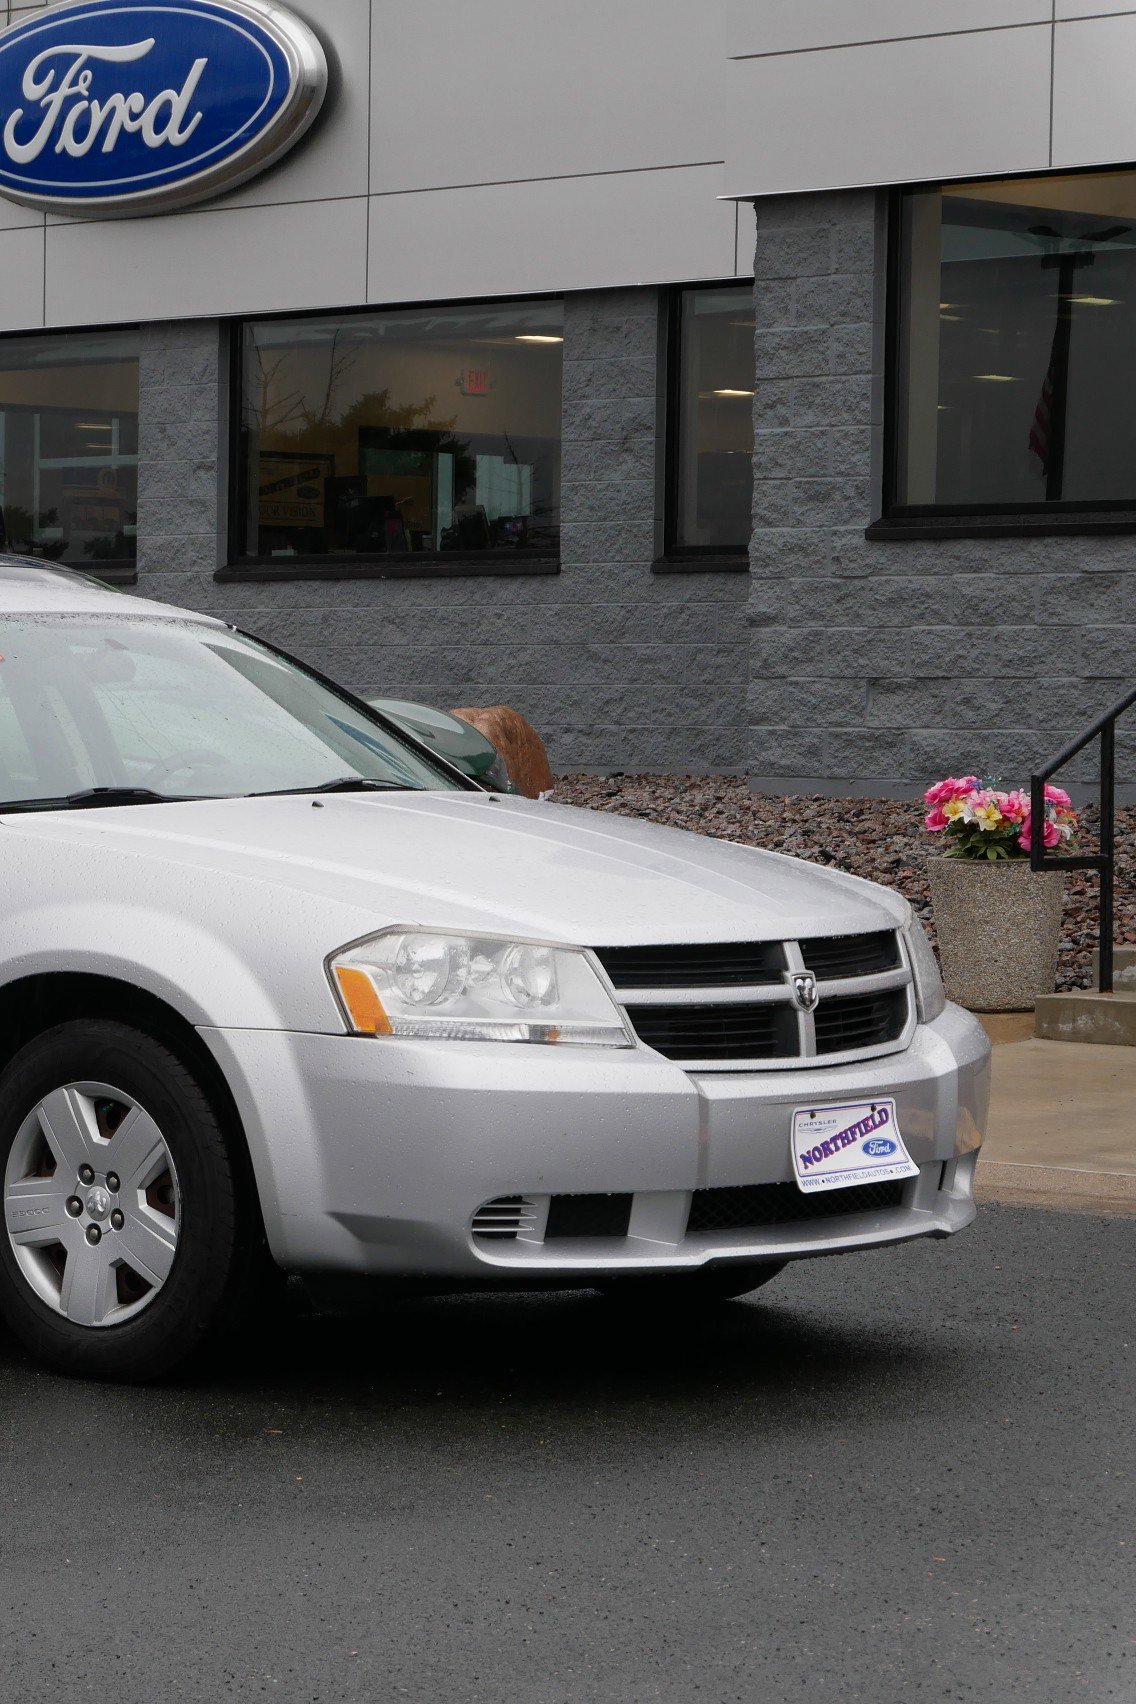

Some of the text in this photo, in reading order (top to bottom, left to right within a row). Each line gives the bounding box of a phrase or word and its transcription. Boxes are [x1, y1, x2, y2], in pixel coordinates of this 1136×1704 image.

[4, 37, 208, 164] Ford
[468, 369, 487, 389] EXIT
[798, 1119, 837, 1128] CHRYSLER
[799, 1107, 889, 1169] NORTHFIELD
[868, 1139, 892, 1156] Ford
